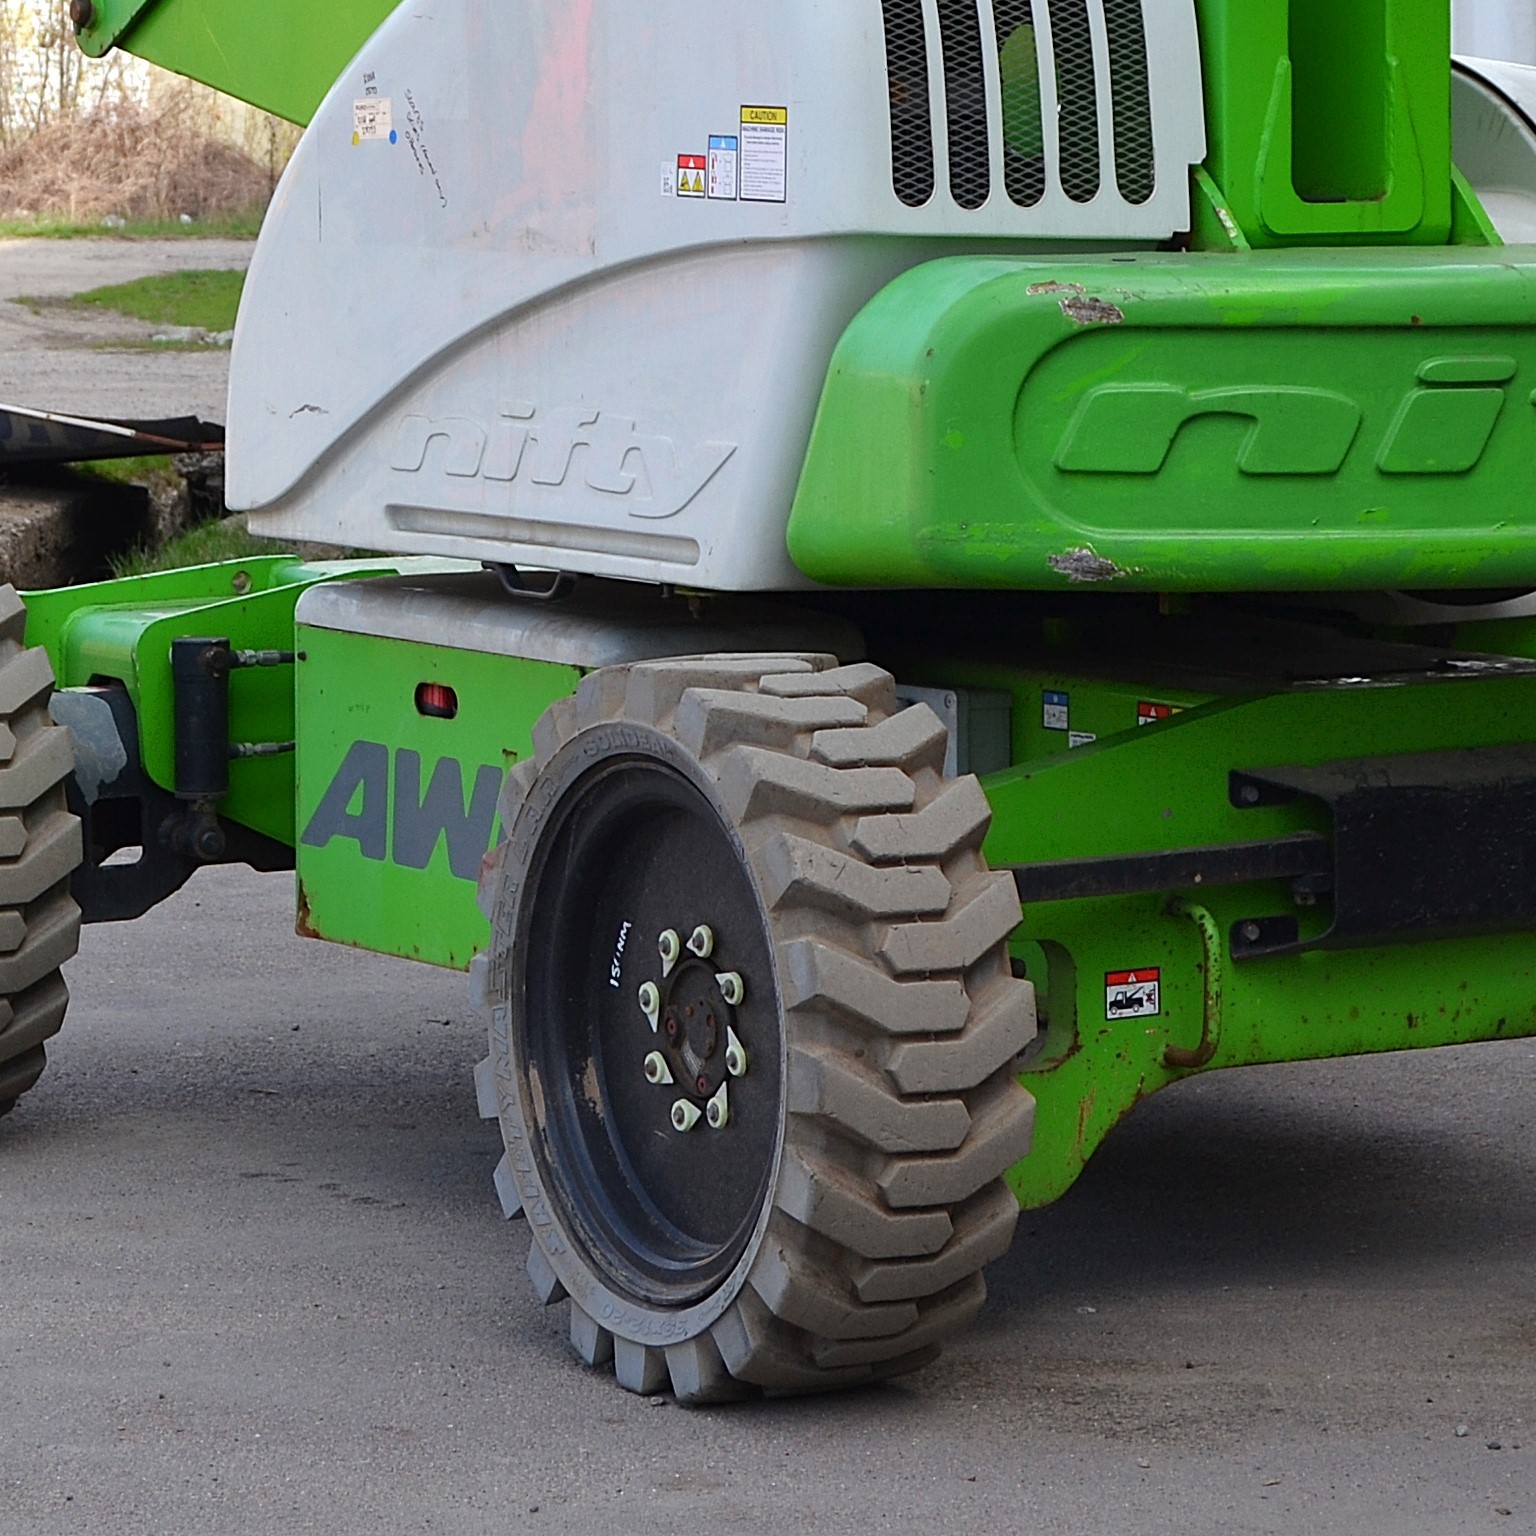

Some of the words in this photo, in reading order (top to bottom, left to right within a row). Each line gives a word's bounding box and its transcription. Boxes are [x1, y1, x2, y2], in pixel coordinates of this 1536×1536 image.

[749, 110, 778, 121] CAUTION
[390, 400, 738, 520] nifty
[302, 739, 504, 882] AW
